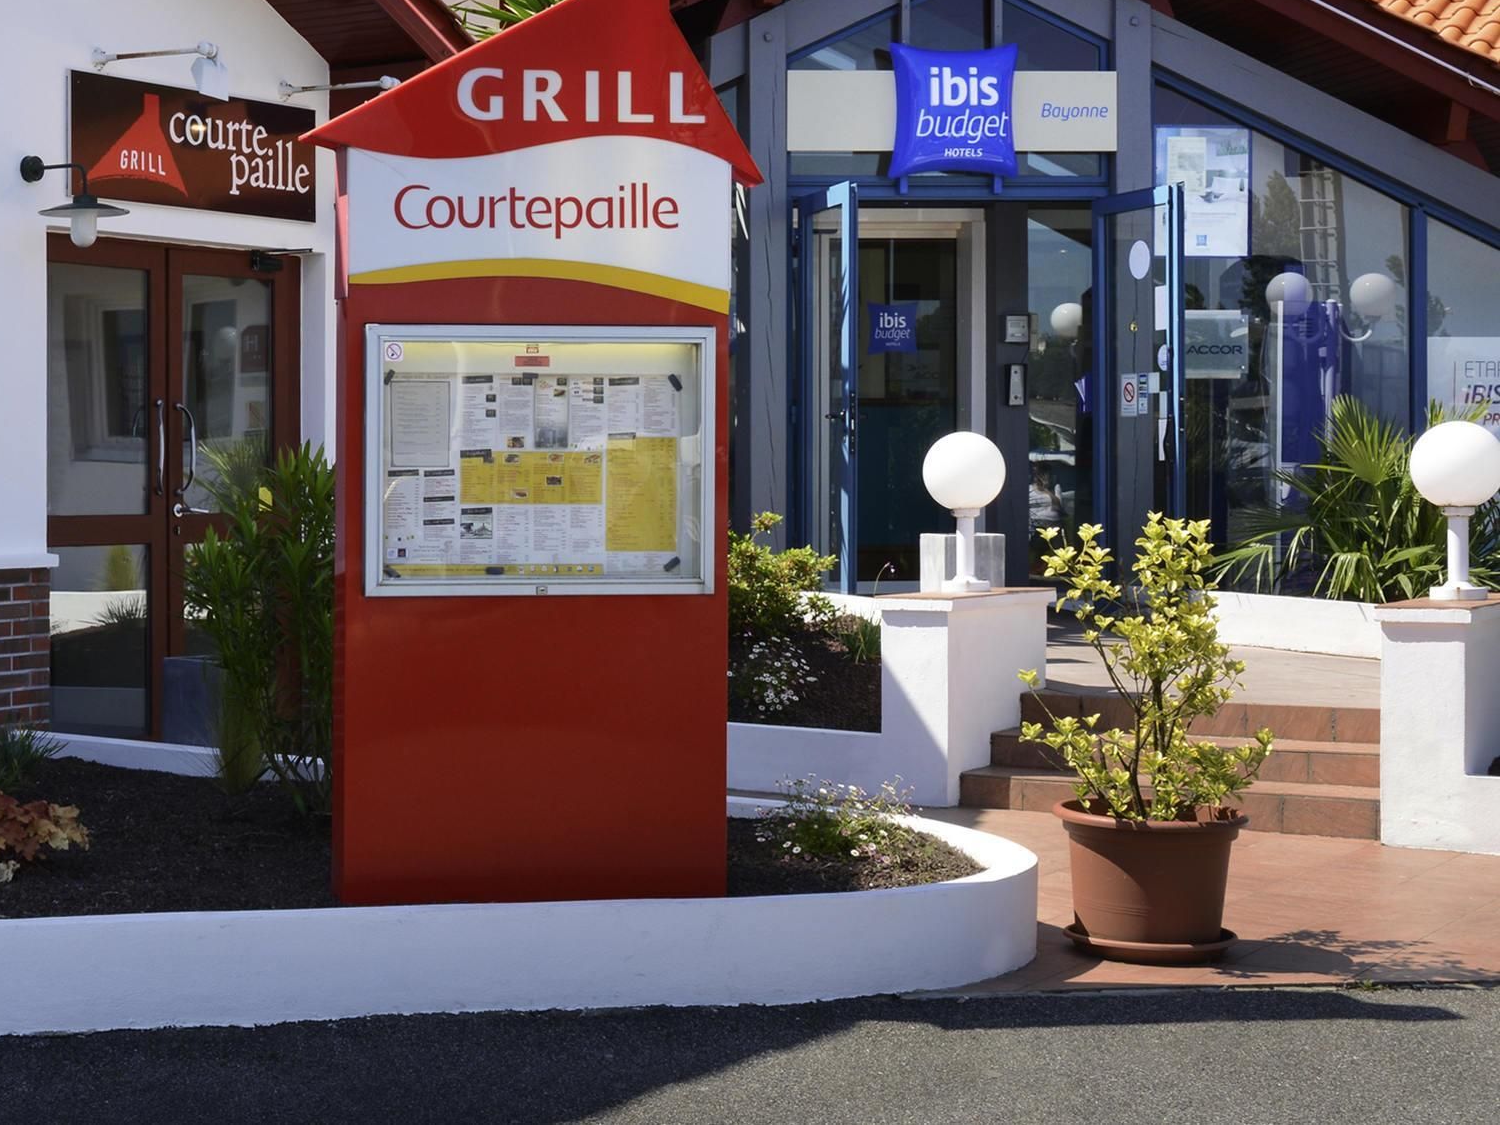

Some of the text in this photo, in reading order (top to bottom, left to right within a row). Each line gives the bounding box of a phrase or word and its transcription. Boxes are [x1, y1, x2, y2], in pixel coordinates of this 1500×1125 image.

[457, 67, 707, 125] GRILL
[929, 66, 1000, 107] ibis
[915, 108, 1009, 144] budget
[1041, 102, 1109, 122] Bayonne
[169, 111, 269, 156] courte
[119, 149, 167, 177] GRILL
[944, 147, 984, 158] HOTELS
[229, 139, 311, 196] paille
[393, 182, 680, 240] Courtepaille
[874, 328, 912, 341] budget
[879, 312, 907, 329] ibis
[1186, 344, 1244, 355] ACCOR
[1464, 360, 1500, 378] ETA
